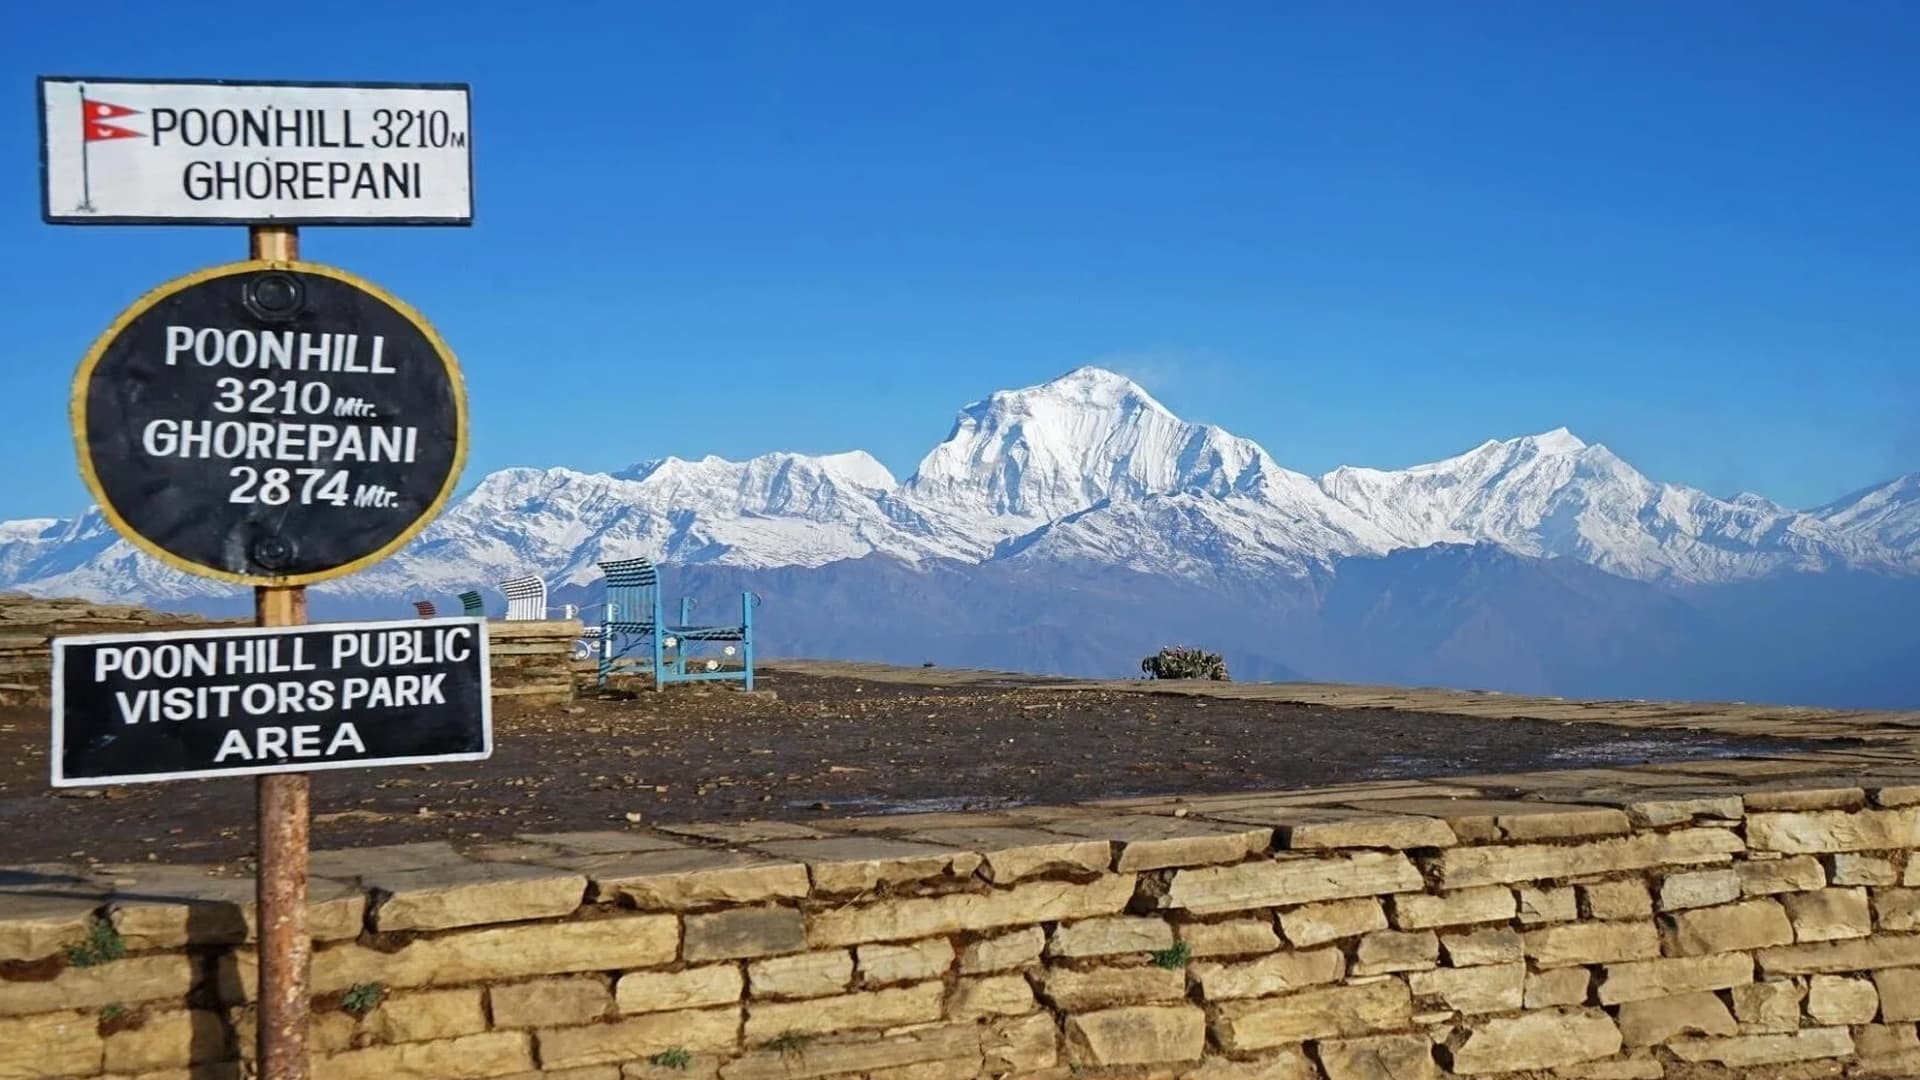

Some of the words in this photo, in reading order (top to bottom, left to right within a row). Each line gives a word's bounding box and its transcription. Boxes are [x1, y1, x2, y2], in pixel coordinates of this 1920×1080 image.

[183, 160, 421, 201] GHOREPANI
[213, 377, 331, 415] 3210
[142, 419, 418, 463] GHOREPANI
[229, 466, 349, 507] 2874
[332, 627, 471, 669] PUBLIC
[116, 679, 336, 725] VISITORS
[342, 672, 447, 710] PARK
[213, 722, 366, 763] AREA
